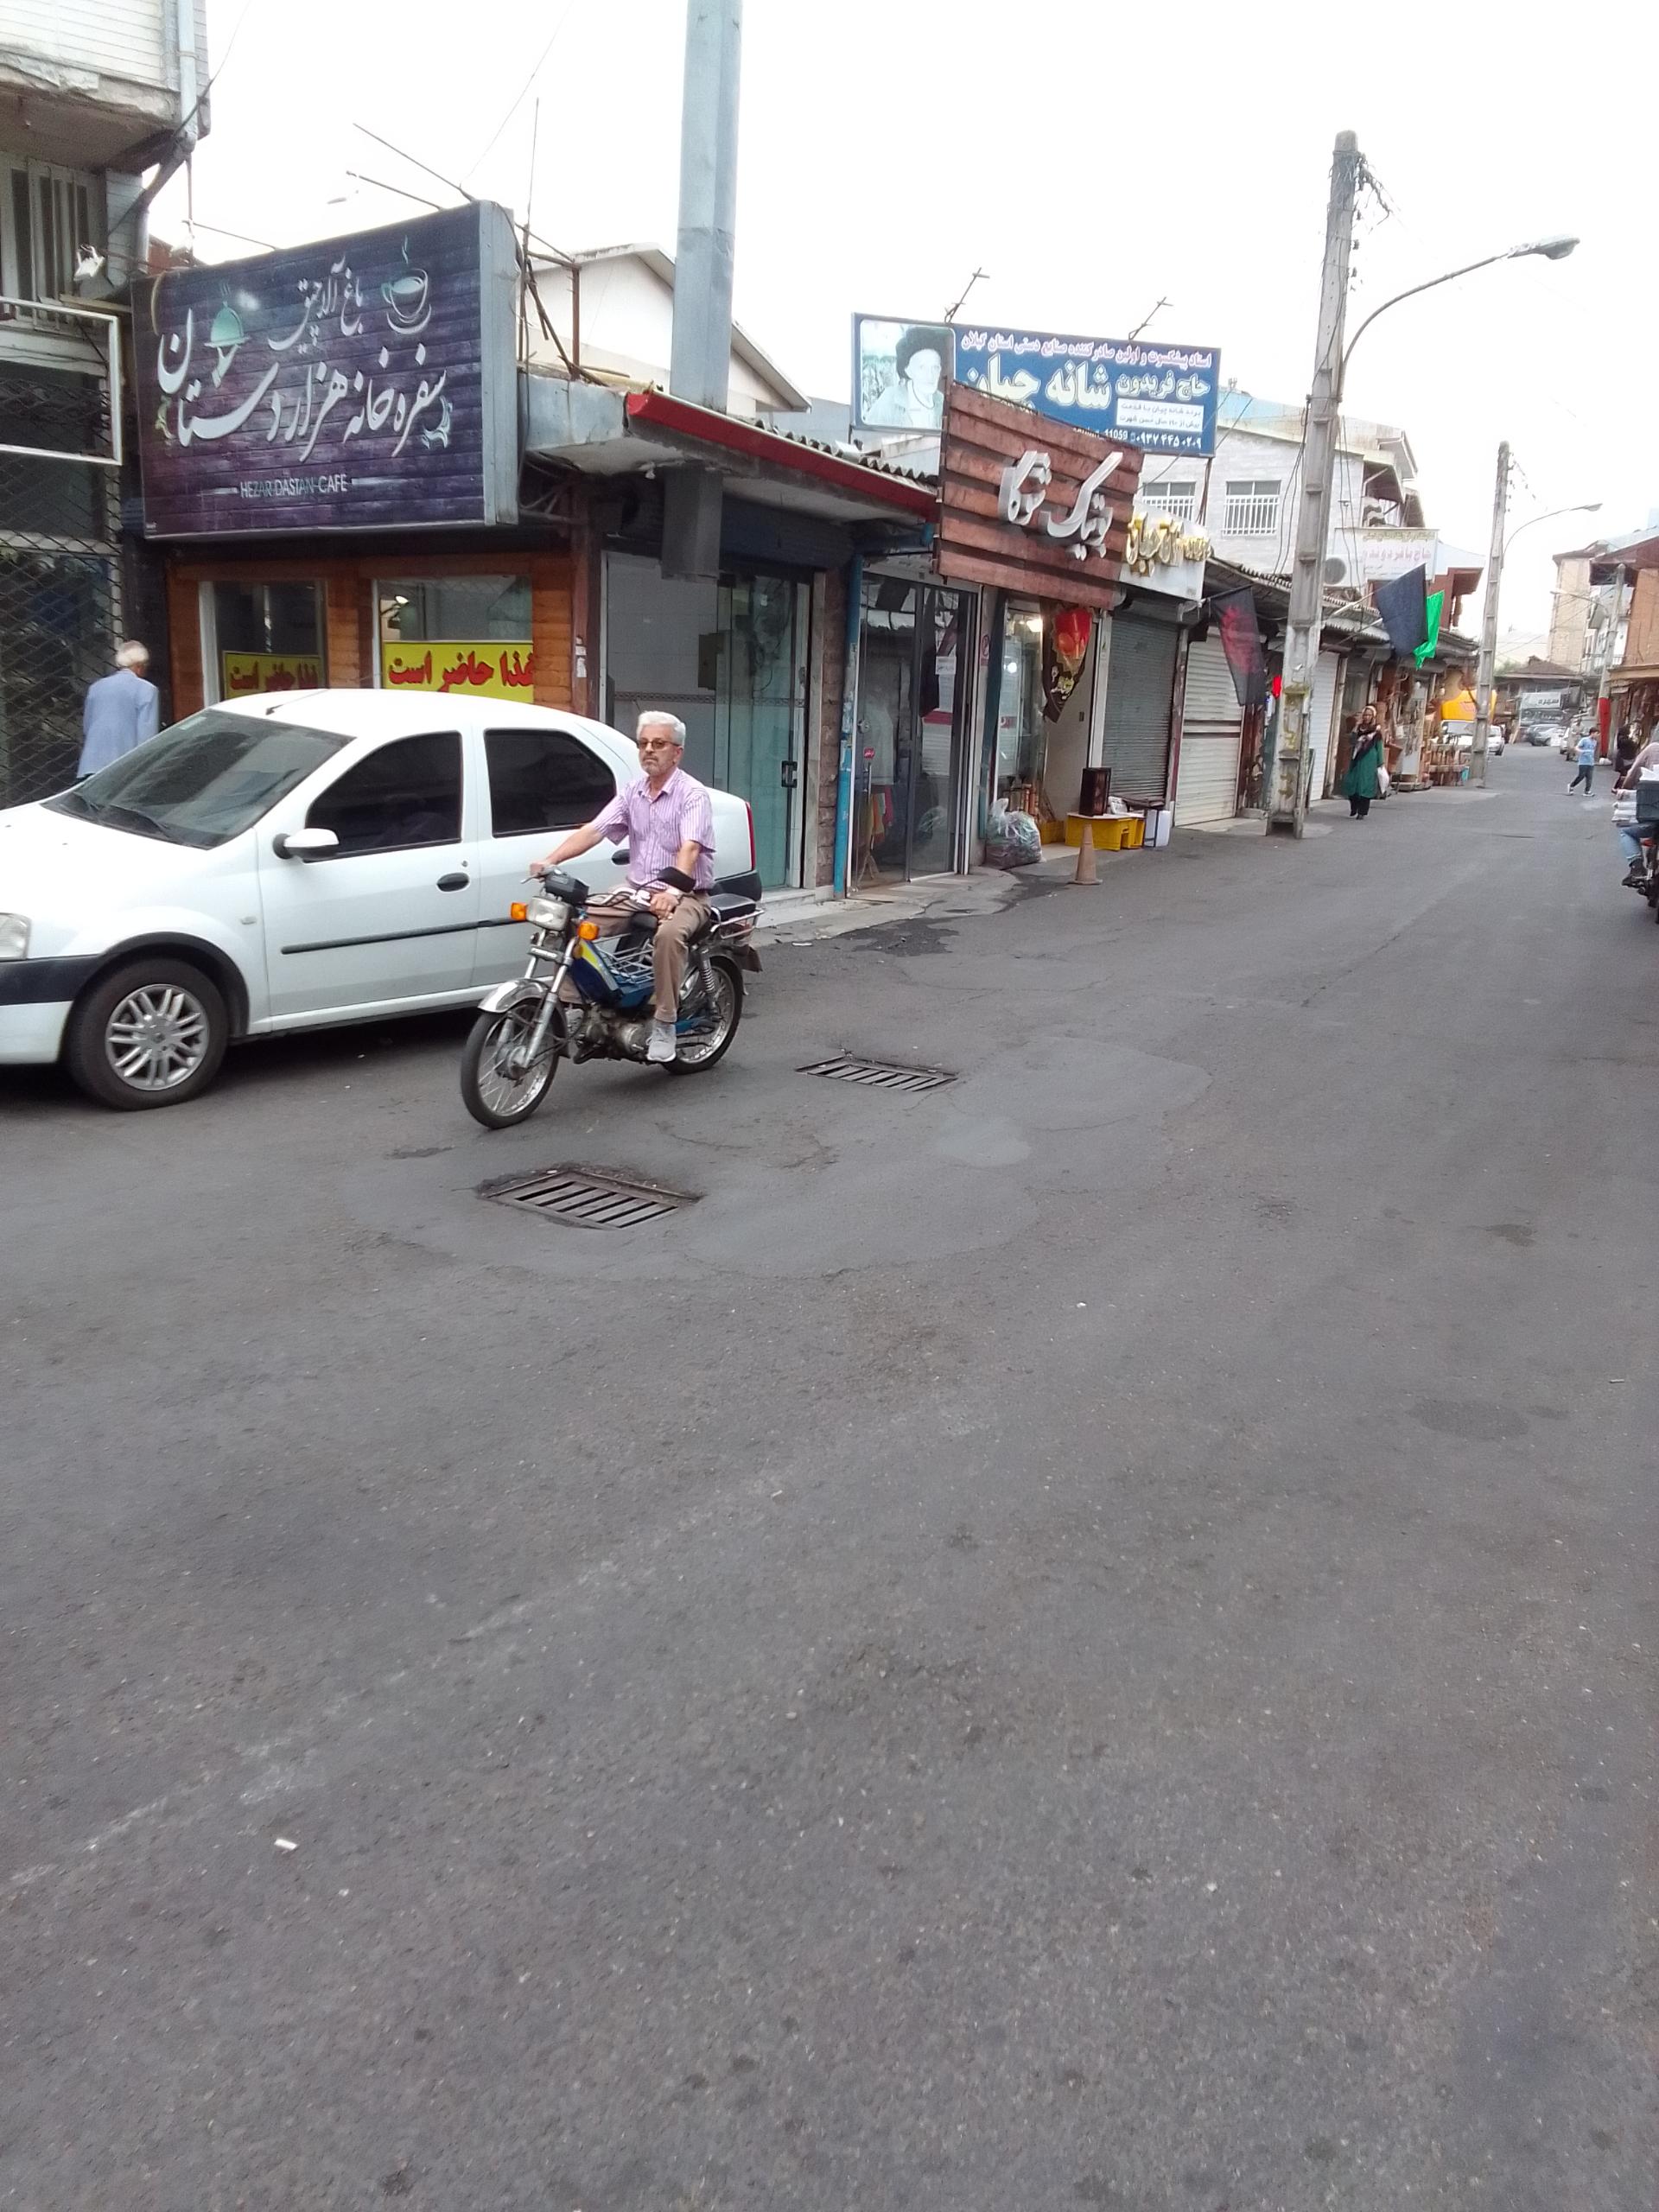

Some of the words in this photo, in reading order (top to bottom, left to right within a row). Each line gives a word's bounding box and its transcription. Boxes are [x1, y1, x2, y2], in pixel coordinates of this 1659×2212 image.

[267, 255, 346, 354] آلاچیق
[340, 267, 363, 336] باغ
[961, 330, 987, 350] گیلان
[987, 333, 1014, 352] استان
[1014, 336, 1041, 355] دستی
[1040, 337, 1068, 357] صنایع
[1116, 345, 1141, 365] اولین
[1140, 353, 1147, 366] و
[1189, 353, 1212, 368] استاد
[342, 346, 396, 444] خانه
[1046, 359, 1112, 410] شانه
[1116, 370, 1175, 399] فریدون
[1176, 373, 1211, 401] حاج
[392, 343, 448, 457] سفره
[240, 480, 272, 499] HEZAR
[275, 477, 315, 497] DASTAN
[318, 474, 348, 493] CAFE
[230, 661, 258, 690] است
[390, 651, 431, 684] است
[499, 650, 533, 687] غذا
